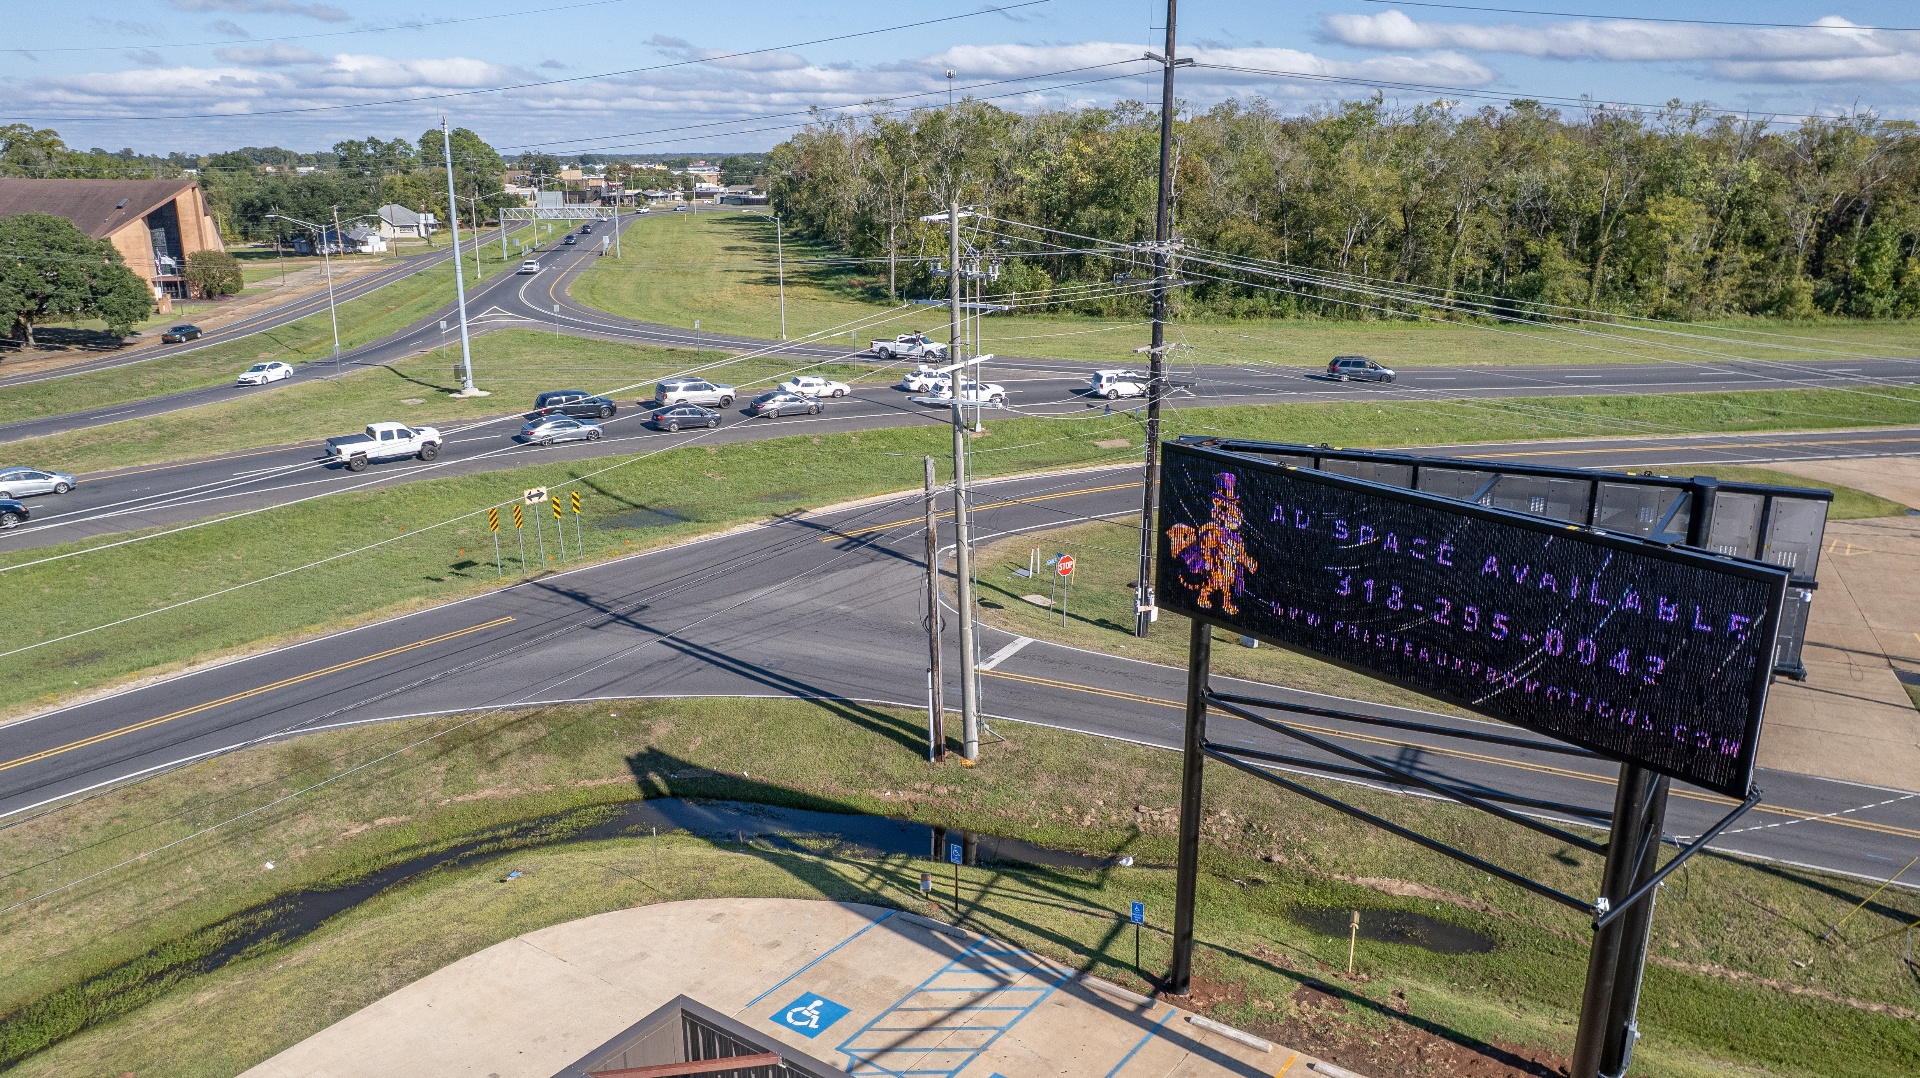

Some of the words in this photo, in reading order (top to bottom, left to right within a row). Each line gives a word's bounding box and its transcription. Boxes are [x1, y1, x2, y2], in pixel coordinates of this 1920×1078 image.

[1058, 560, 1074, 571] STOP
[1270, 504, 1310, 530] AD
[1333, 519, 1454, 567] SPACE
[1481, 555, 1751, 641] AVAILABLE
